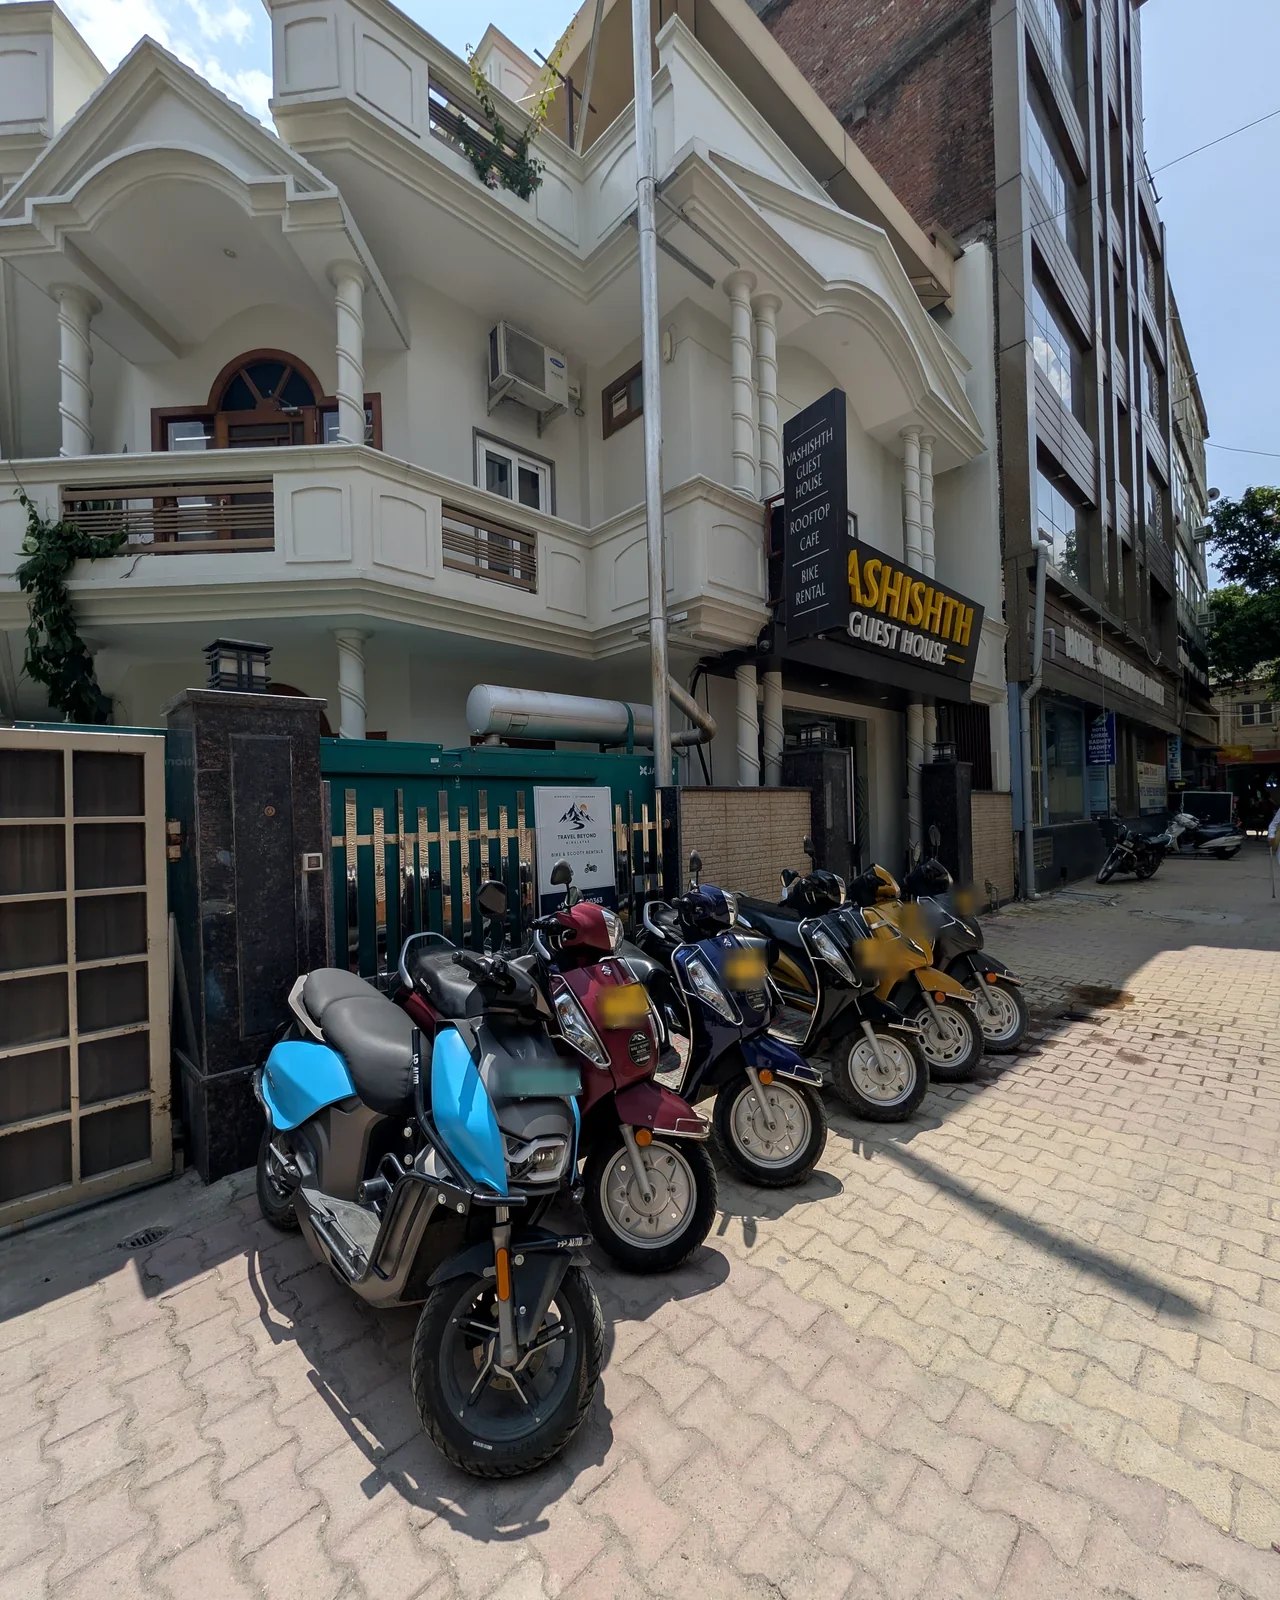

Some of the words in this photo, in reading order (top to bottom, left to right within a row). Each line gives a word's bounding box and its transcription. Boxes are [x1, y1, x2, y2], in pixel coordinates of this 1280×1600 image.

[786, 427, 833, 467] VASHISHTH
[796, 453, 822, 480] GUEST
[795, 473, 823, 499] HOUSE
[790, 503, 830, 535] ROOFTOP
[799, 530, 820, 551] CAFE
[801, 564, 819, 584] BIKE
[795, 582, 826, 606] RENTAL
[847, 611, 900, 650] GUEST
[899, 629, 947, 666] HOUSE
